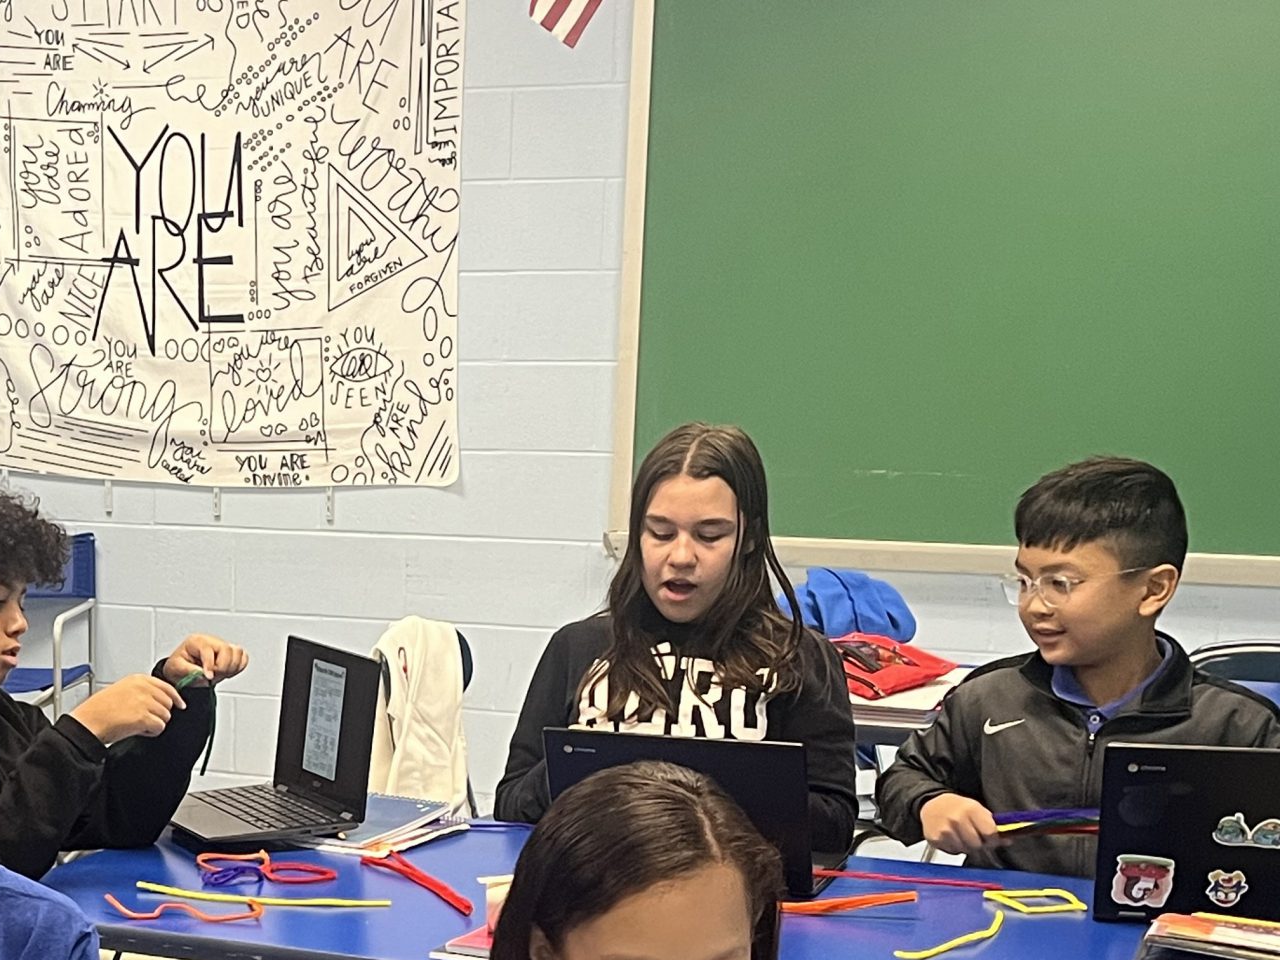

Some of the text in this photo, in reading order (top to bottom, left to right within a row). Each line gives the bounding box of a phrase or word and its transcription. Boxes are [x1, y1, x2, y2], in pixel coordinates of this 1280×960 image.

[35, 29, 65, 46] YOU
[44, 53, 75, 71] ARE
[324, 26, 399, 114] ARE
[261, 71, 312, 117] UNIQUE
[21, 135, 61, 208] you
[40, 141, 62, 203] are
[108, 124, 244, 236] YOU
[267, 161, 316, 311] you are
[19, 261, 48, 312] you
[40, 262, 65, 306] are
[59, 263, 106, 330] NICE
[92, 210, 245, 356] ARE
[349, 257, 403, 293] FORGIVEN
[104, 336, 137, 359] YOU
[339, 326, 376, 346] YOU
[104, 361, 135, 379] ARE
[222, 340, 319, 433] loved
[330, 380, 388, 409] SEEN
[235, 453, 311, 472] YOU ARE
